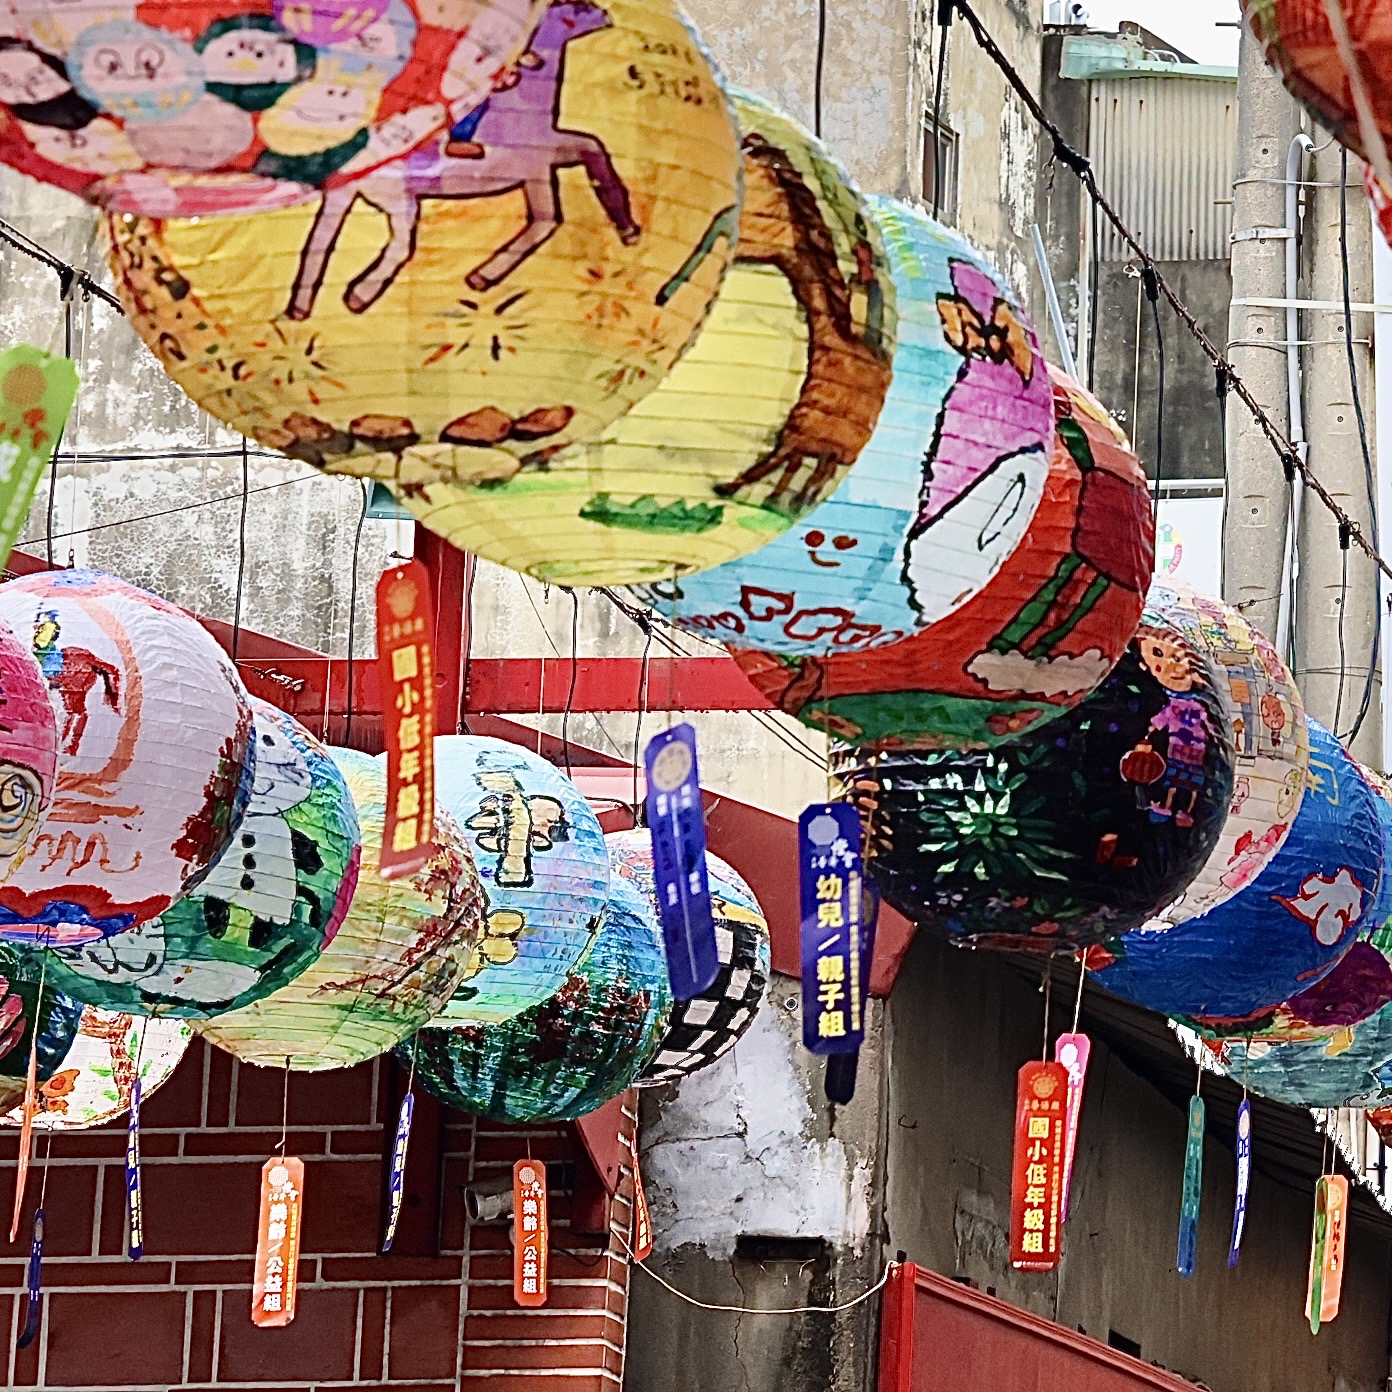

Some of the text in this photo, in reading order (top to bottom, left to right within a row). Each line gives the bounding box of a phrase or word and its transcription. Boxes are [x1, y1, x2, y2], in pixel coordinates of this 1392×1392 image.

[816, 873, 847, 1038] 幼兒/親子組
[1022, 1117, 1050, 1253] 國小低年級組
[263, 1203, 288, 1312] 樂齡/公益組
[522, 1199, 538, 1294] 樂齡/公益組
